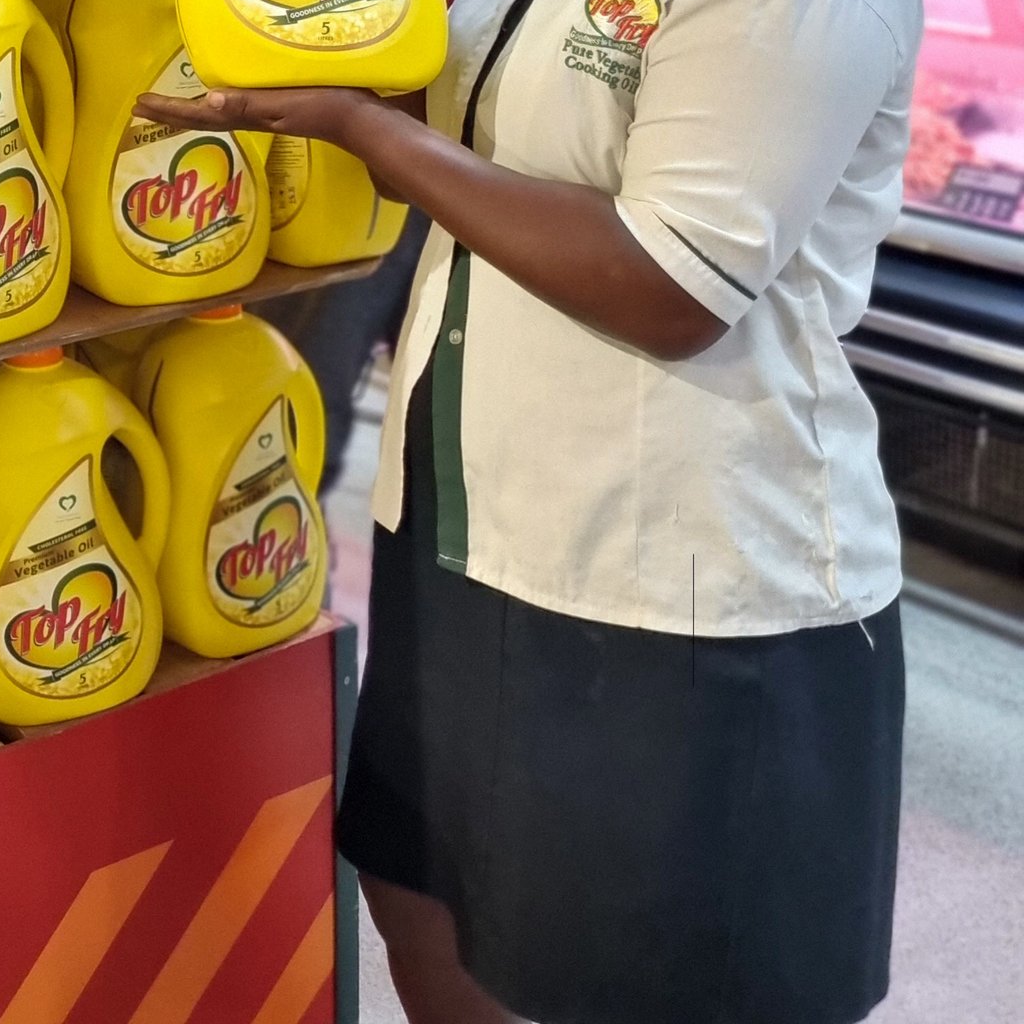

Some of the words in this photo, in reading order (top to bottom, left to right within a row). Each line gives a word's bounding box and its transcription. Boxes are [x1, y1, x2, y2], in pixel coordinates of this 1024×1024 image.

[321, 22, 330, 35] 5
[564, 56, 621, 89] Cooking
[596, 49, 641, 82] Vegetab
[134, 124, 182, 144] Veget
[4, 140, 17, 155] Oil
[193, 250, 200, 261] 5
[5, 289, 11, 301] 5
[15, 549, 74, 578] Vegetable
[78, 538, 92, 552] Oil
[79, 672, 86, 683] 5
